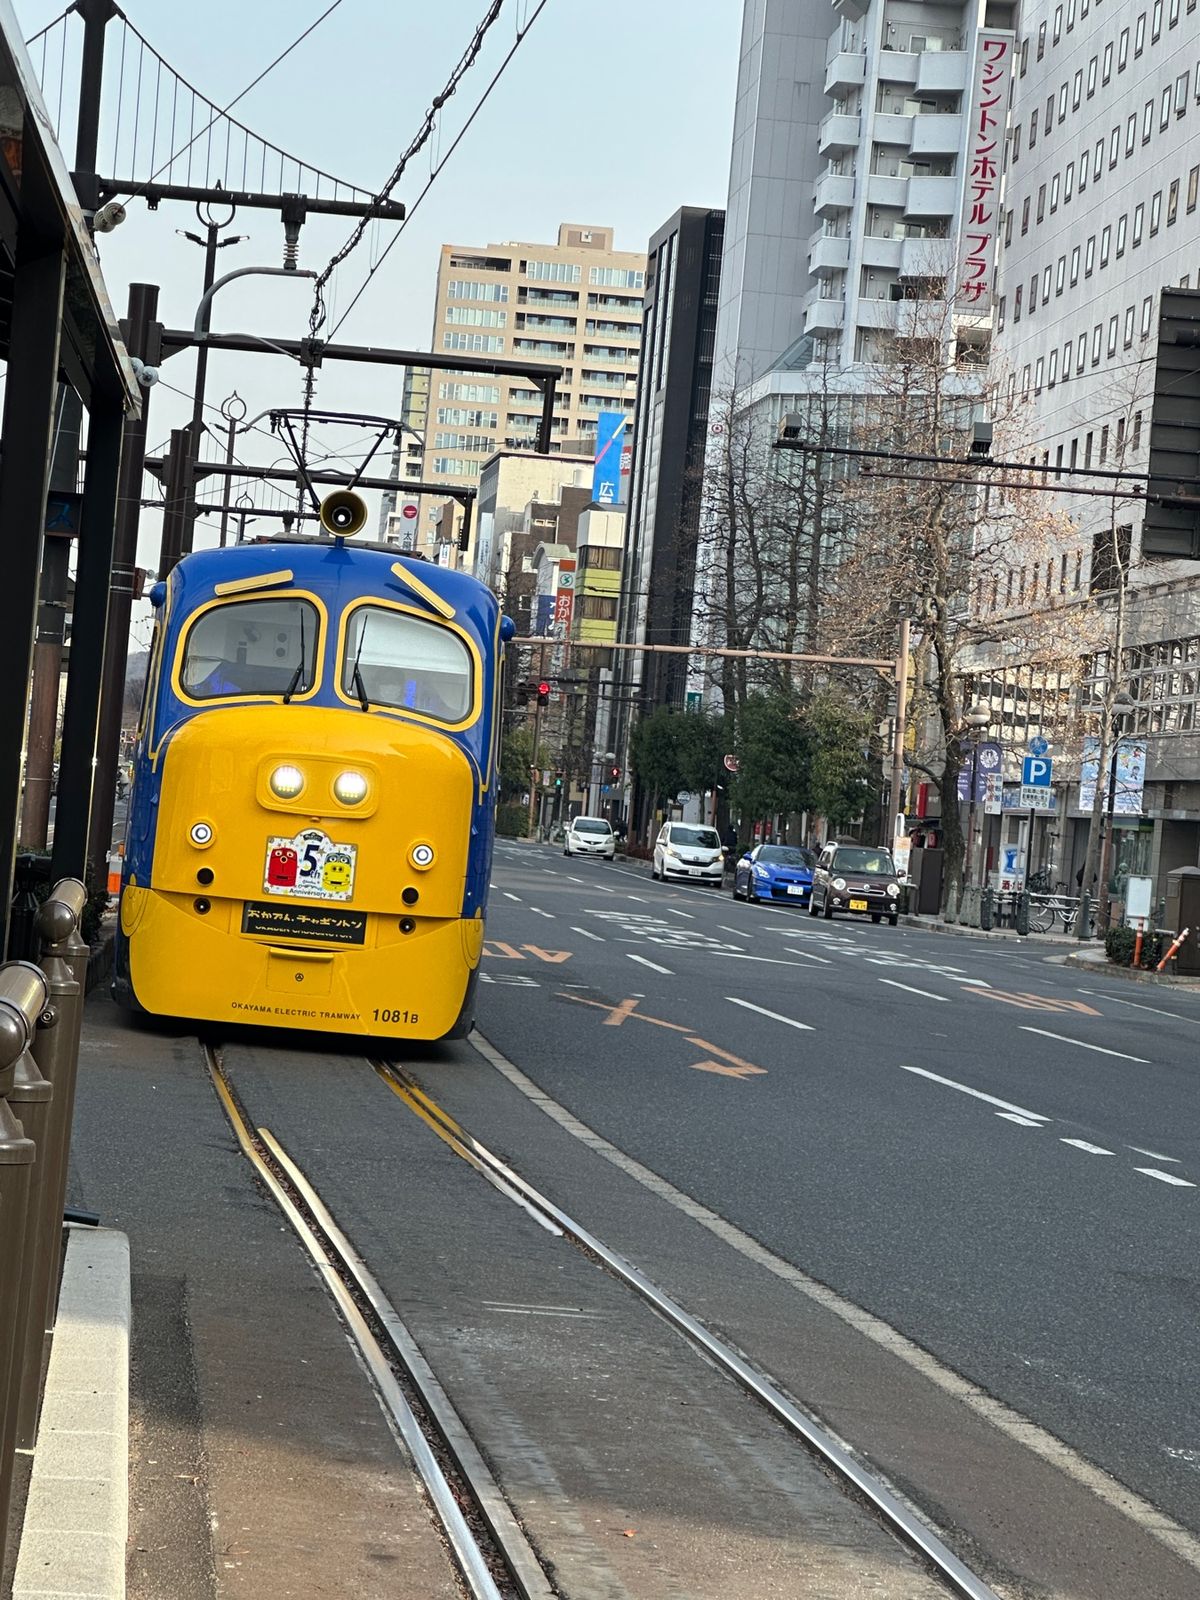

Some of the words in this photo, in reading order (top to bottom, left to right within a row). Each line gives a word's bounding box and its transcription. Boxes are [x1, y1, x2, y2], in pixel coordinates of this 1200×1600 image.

[1030, 760, 1047, 783] P
[299, 844, 321, 879] 5th
[289, 888, 326, 898] Anniversary
[231, 1002, 272, 1013] OKAYAMA
[274, 1007, 317, 1018] ELECTRIC
[319, 1011, 361, 1021] TRAMWAY
[372, 1008, 419, 1024] 1081B
